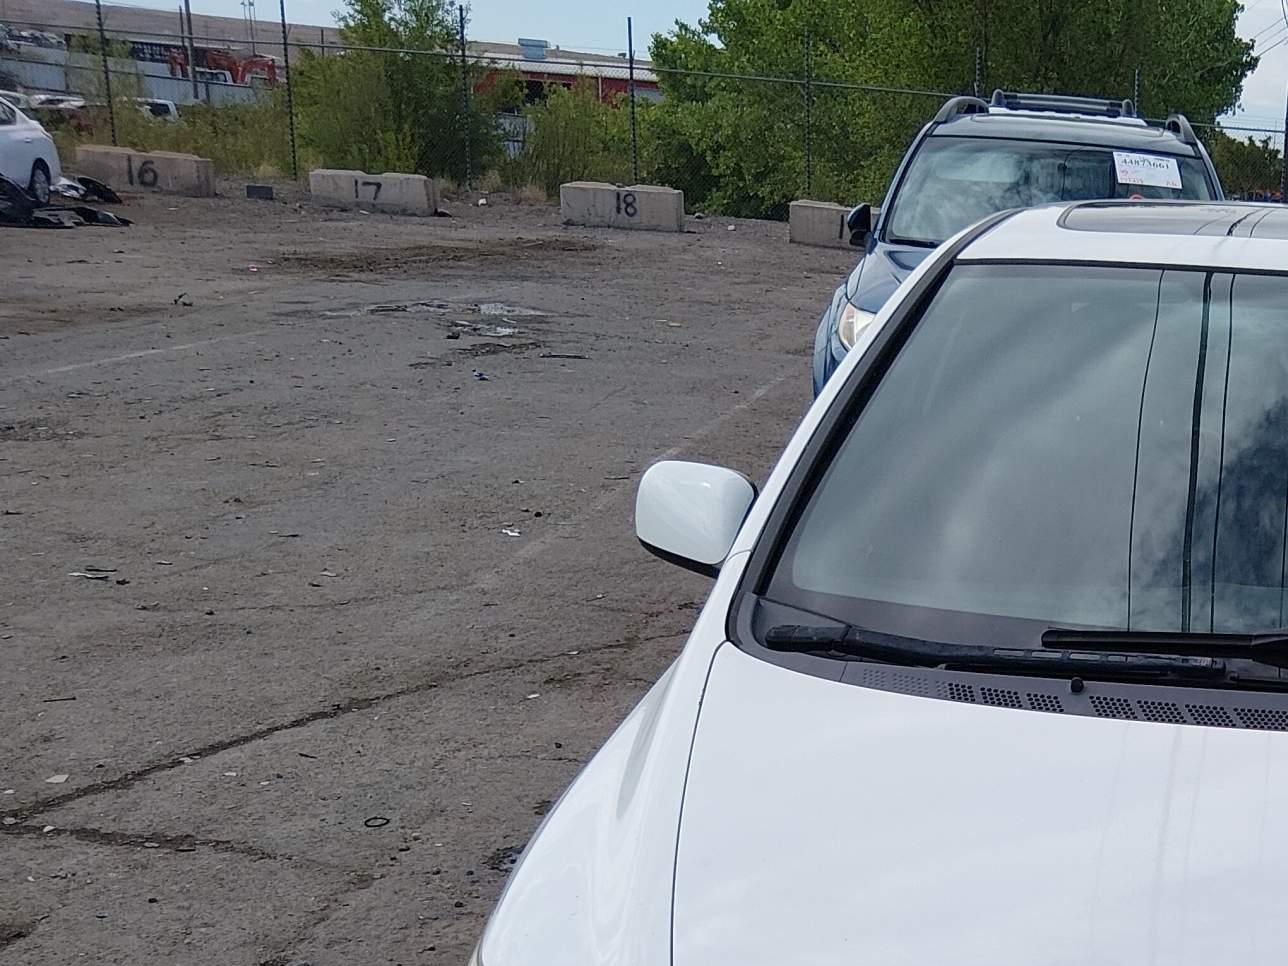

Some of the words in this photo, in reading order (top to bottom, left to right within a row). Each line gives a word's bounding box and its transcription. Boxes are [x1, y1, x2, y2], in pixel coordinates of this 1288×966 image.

[126, 154, 159, 188] 16
[354, 178, 383, 201] 17
[615, 191, 638, 218] 18
